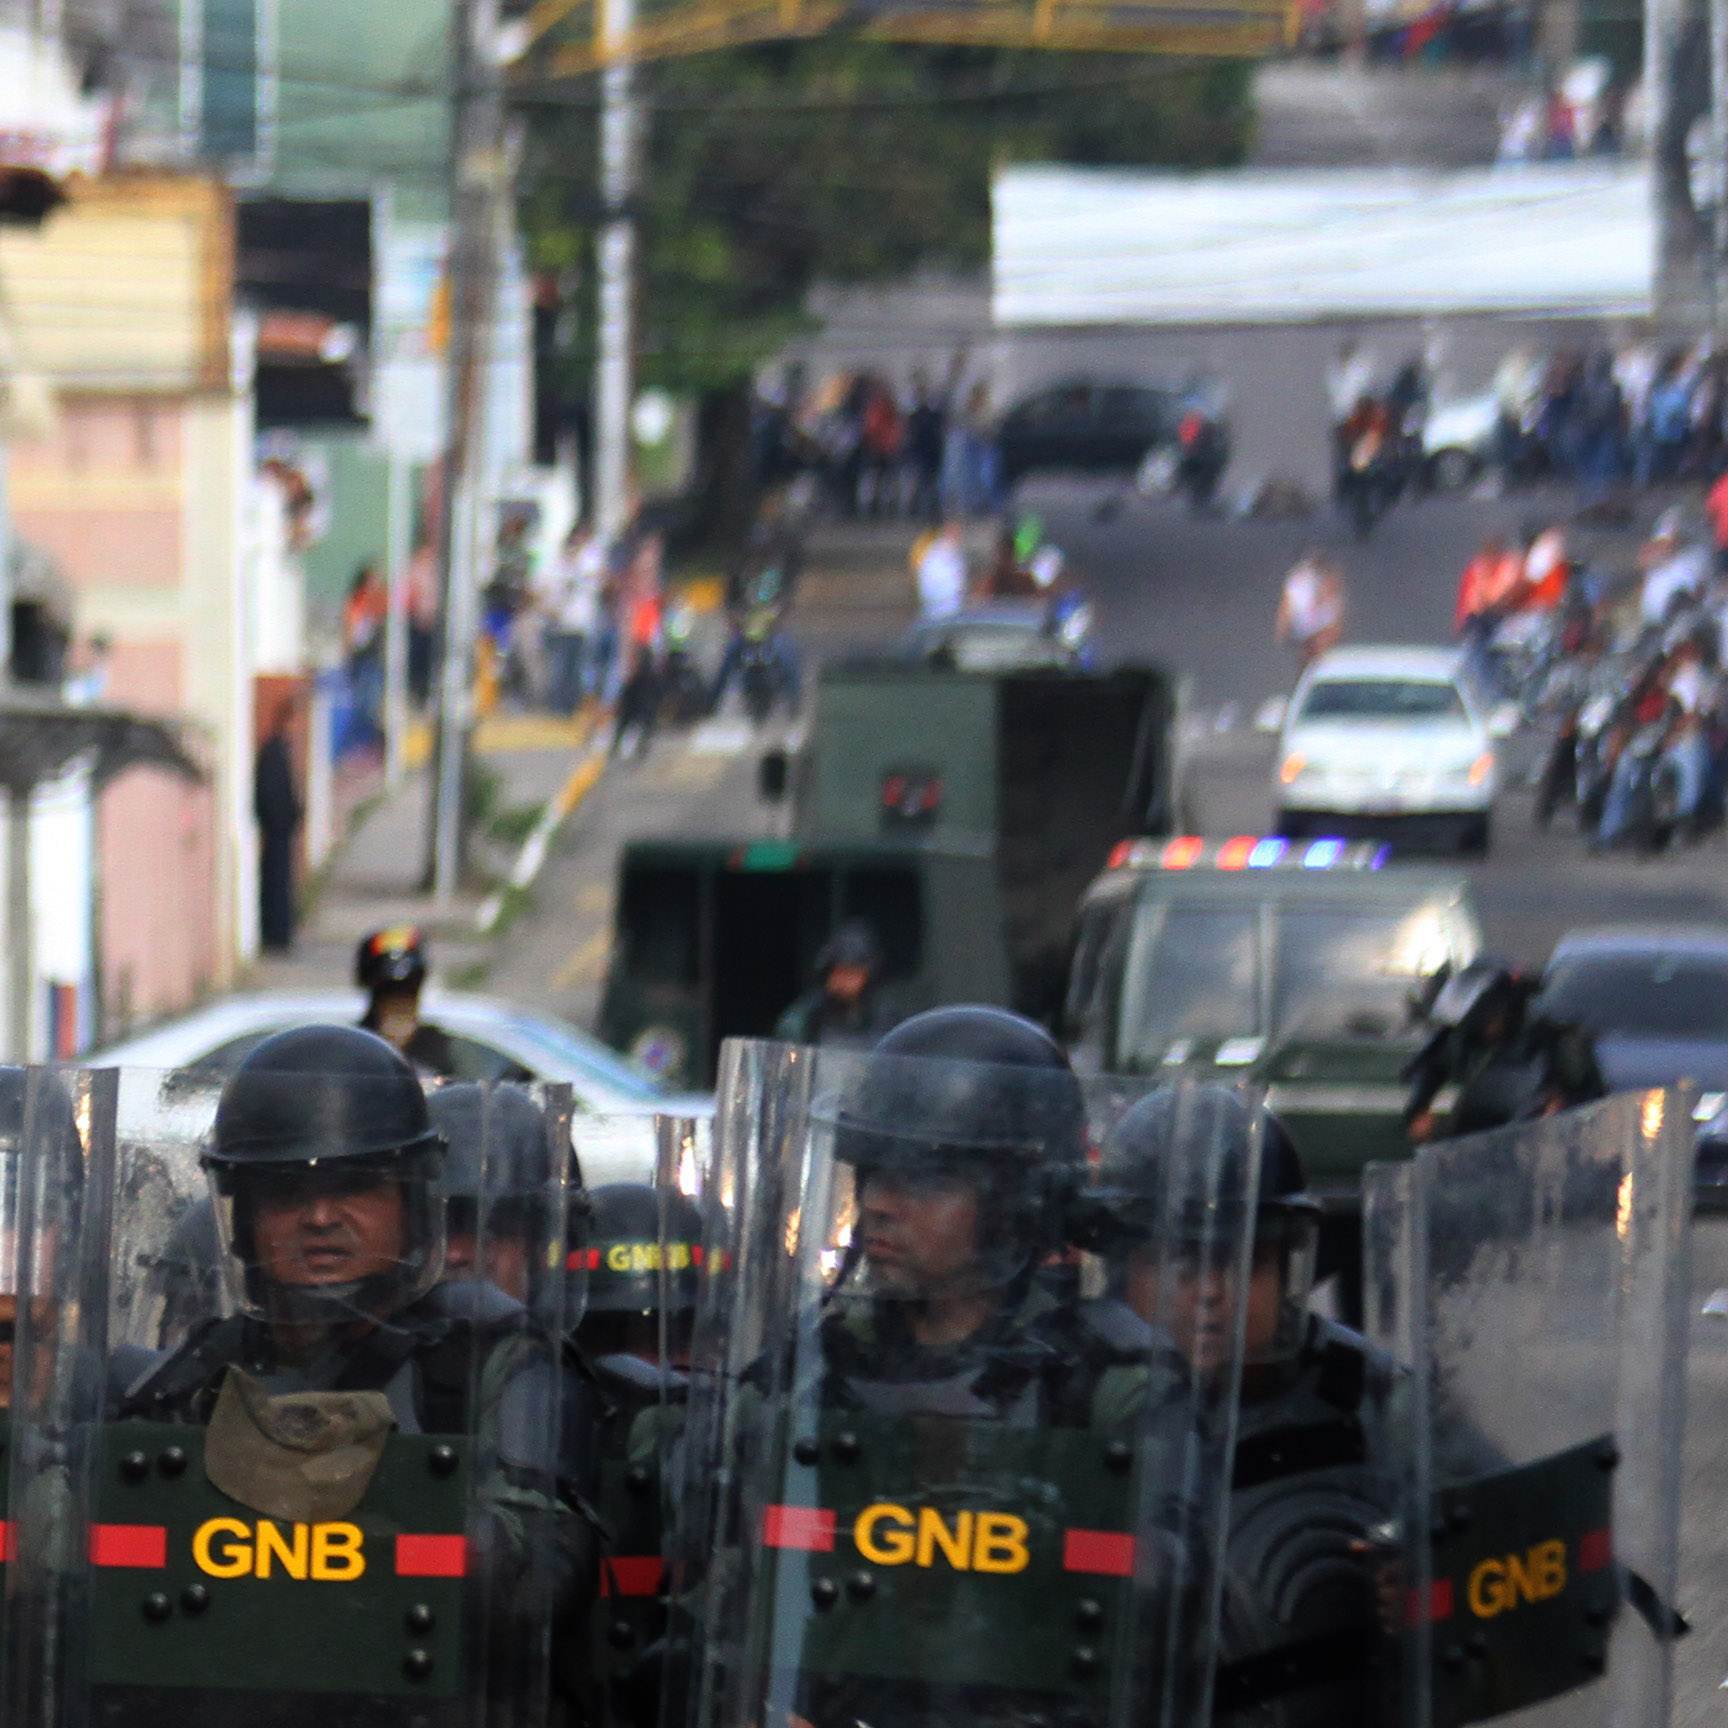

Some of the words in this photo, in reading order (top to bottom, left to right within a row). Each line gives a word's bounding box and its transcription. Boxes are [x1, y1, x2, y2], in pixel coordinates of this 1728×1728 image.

[192, 1516, 367, 1582] GNB
[853, 1503, 1029, 1573] GNB
[1467, 1537, 1568, 1619] GNB
